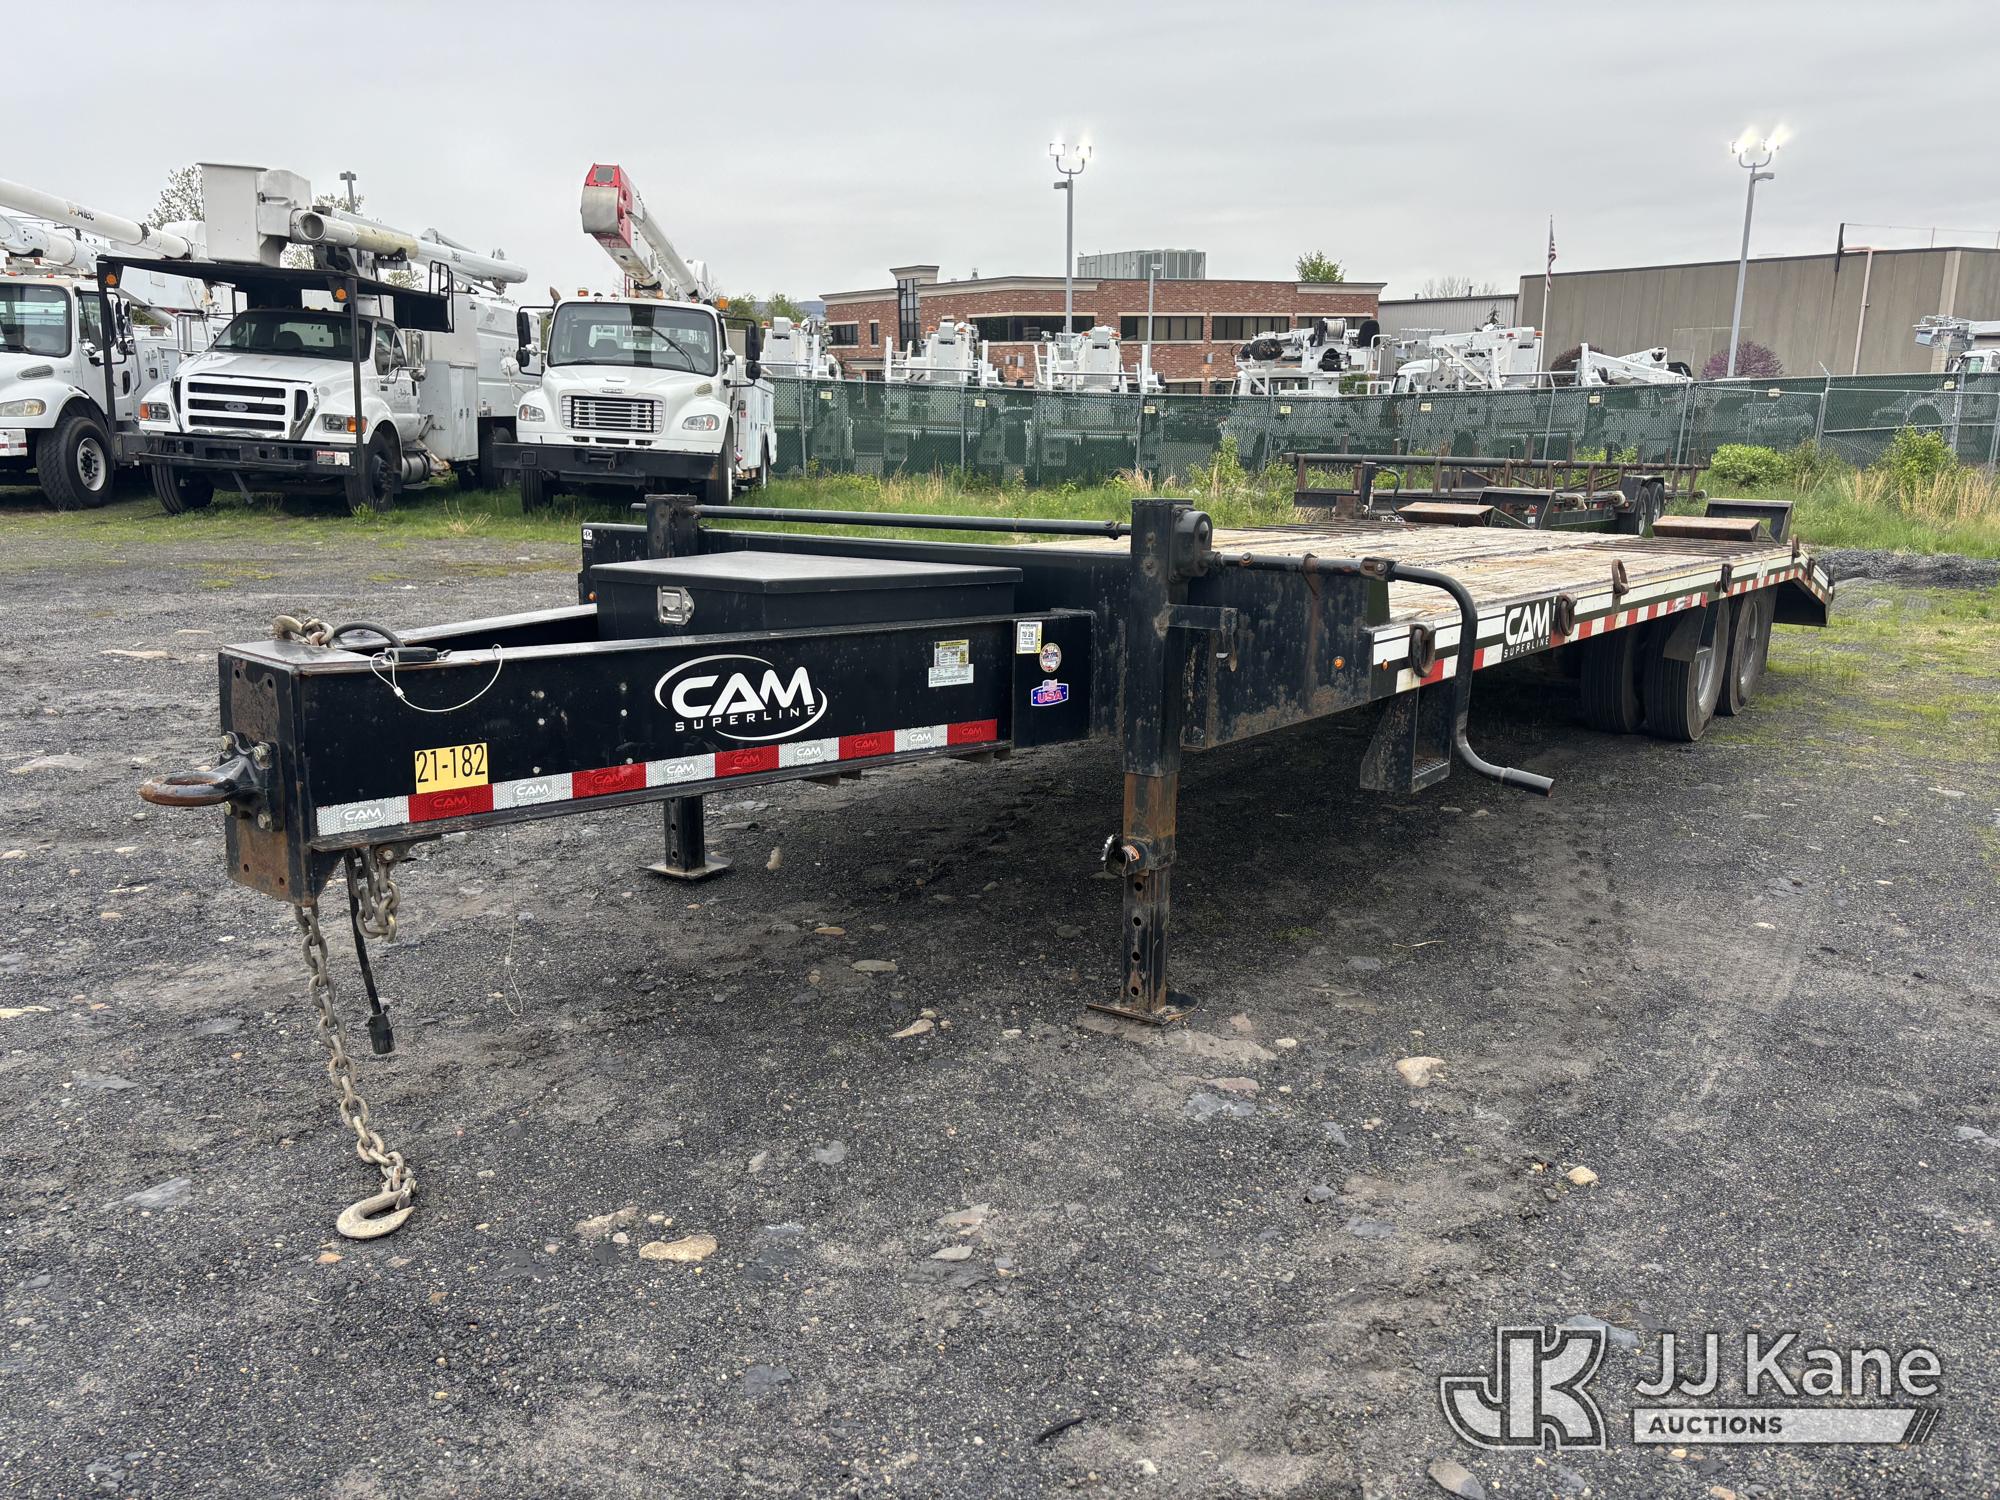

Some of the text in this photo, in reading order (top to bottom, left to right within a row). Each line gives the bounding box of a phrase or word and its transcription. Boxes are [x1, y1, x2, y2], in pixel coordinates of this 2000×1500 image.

[1505, 600, 1550, 646] CAM
[1503, 636, 1550, 658] SUPERLINE
[671, 666, 815, 718] CAM
[1037, 690, 1063, 703] USA
[675, 705, 816, 732] SUPERLINE
[910, 733, 932, 743] CAM
[961, 726, 982, 737] CAM
[855, 738, 879, 748] CAM
[796, 746, 822, 757] CAM
[416, 744, 486, 784] 21-182
[734, 754, 761, 765] CAM
[666, 764, 695, 775] CAM
[594, 773, 625, 786] CAM
[515, 783, 550, 797] CAM
[433, 795, 469, 809] CAM
[343, 807, 383, 821] CAM
